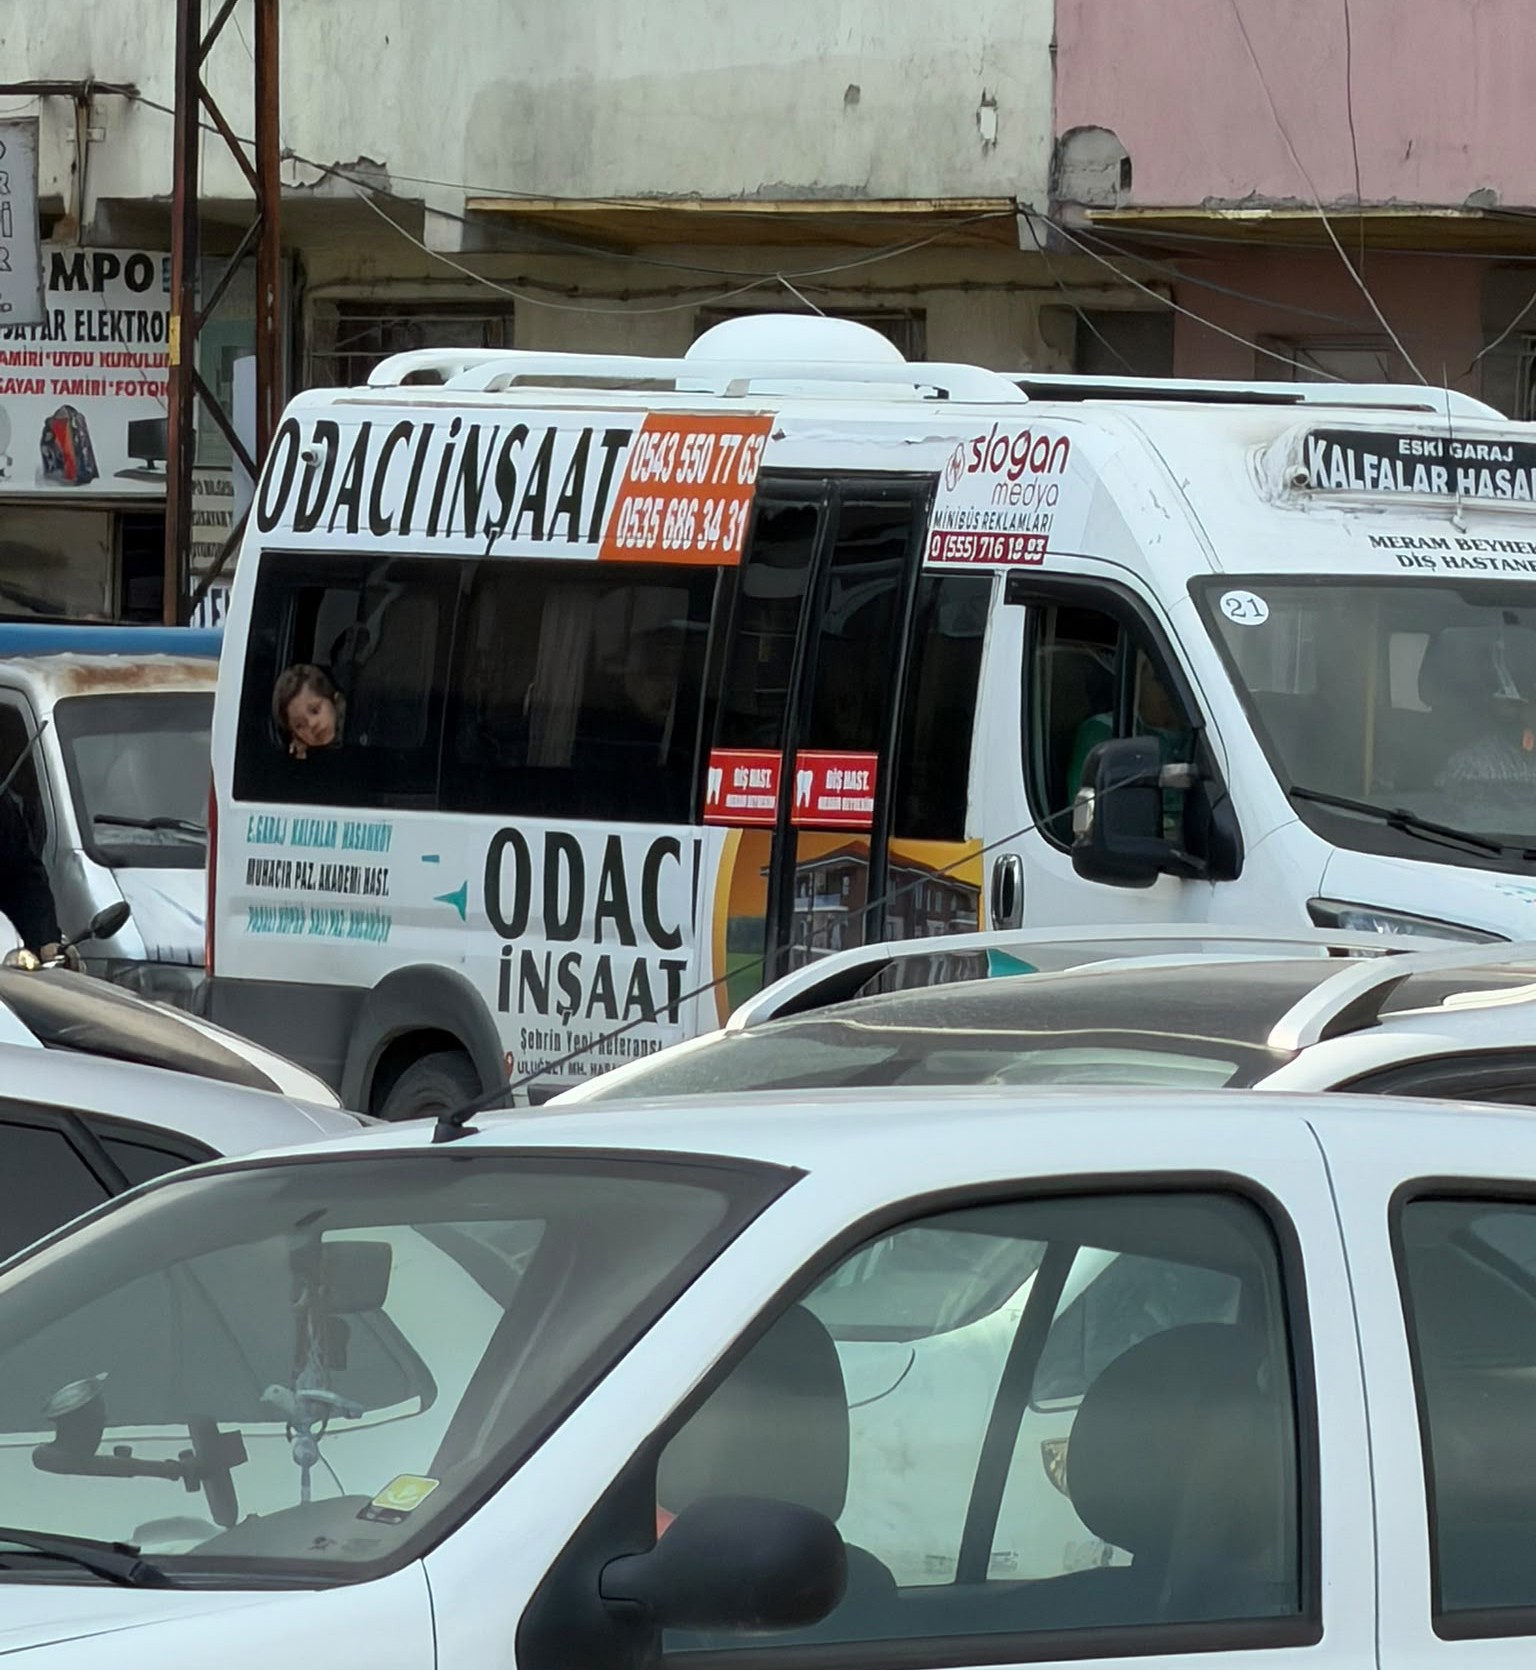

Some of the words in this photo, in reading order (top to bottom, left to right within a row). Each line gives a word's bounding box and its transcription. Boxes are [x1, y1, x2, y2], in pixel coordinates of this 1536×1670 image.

[630, 431, 680, 484] 0543
[676, 432, 716, 484] 550
[711, 434, 743, 484] 77
[737, 433, 766, 485] 63
[967, 422, 1071, 481] slogan
[1307, 435, 1448, 494] KALFALAR
[1399, 437, 1443, 457] ESKİ
[1450, 442, 1513, 462] GARAJ
[256, 417, 435, 536] ODACI
[426, 416, 633, 555] İNŞAAT
[991, 477, 1059, 513] medya
[615, 496, 665, 549] 0535
[662, 497, 699, 550] 686
[697, 498, 726, 550] 34
[722, 499, 750, 552] 31
[934, 506, 981, 530] MİNİBÜS
[982, 512, 1054, 532] REKLAMLARI
[931, 535, 941, 557] 0
[942, 535, 978, 561] (555)
[979, 536, 1005, 560] 716
[1368, 534, 1450, 551] MERAM
[1396, 552, 1436, 573] DİŞ
[1225, 598, 1265, 618] 21
[484, 827, 702, 950] ODACI
[498, 944, 688, 1026] İNŞAAT
